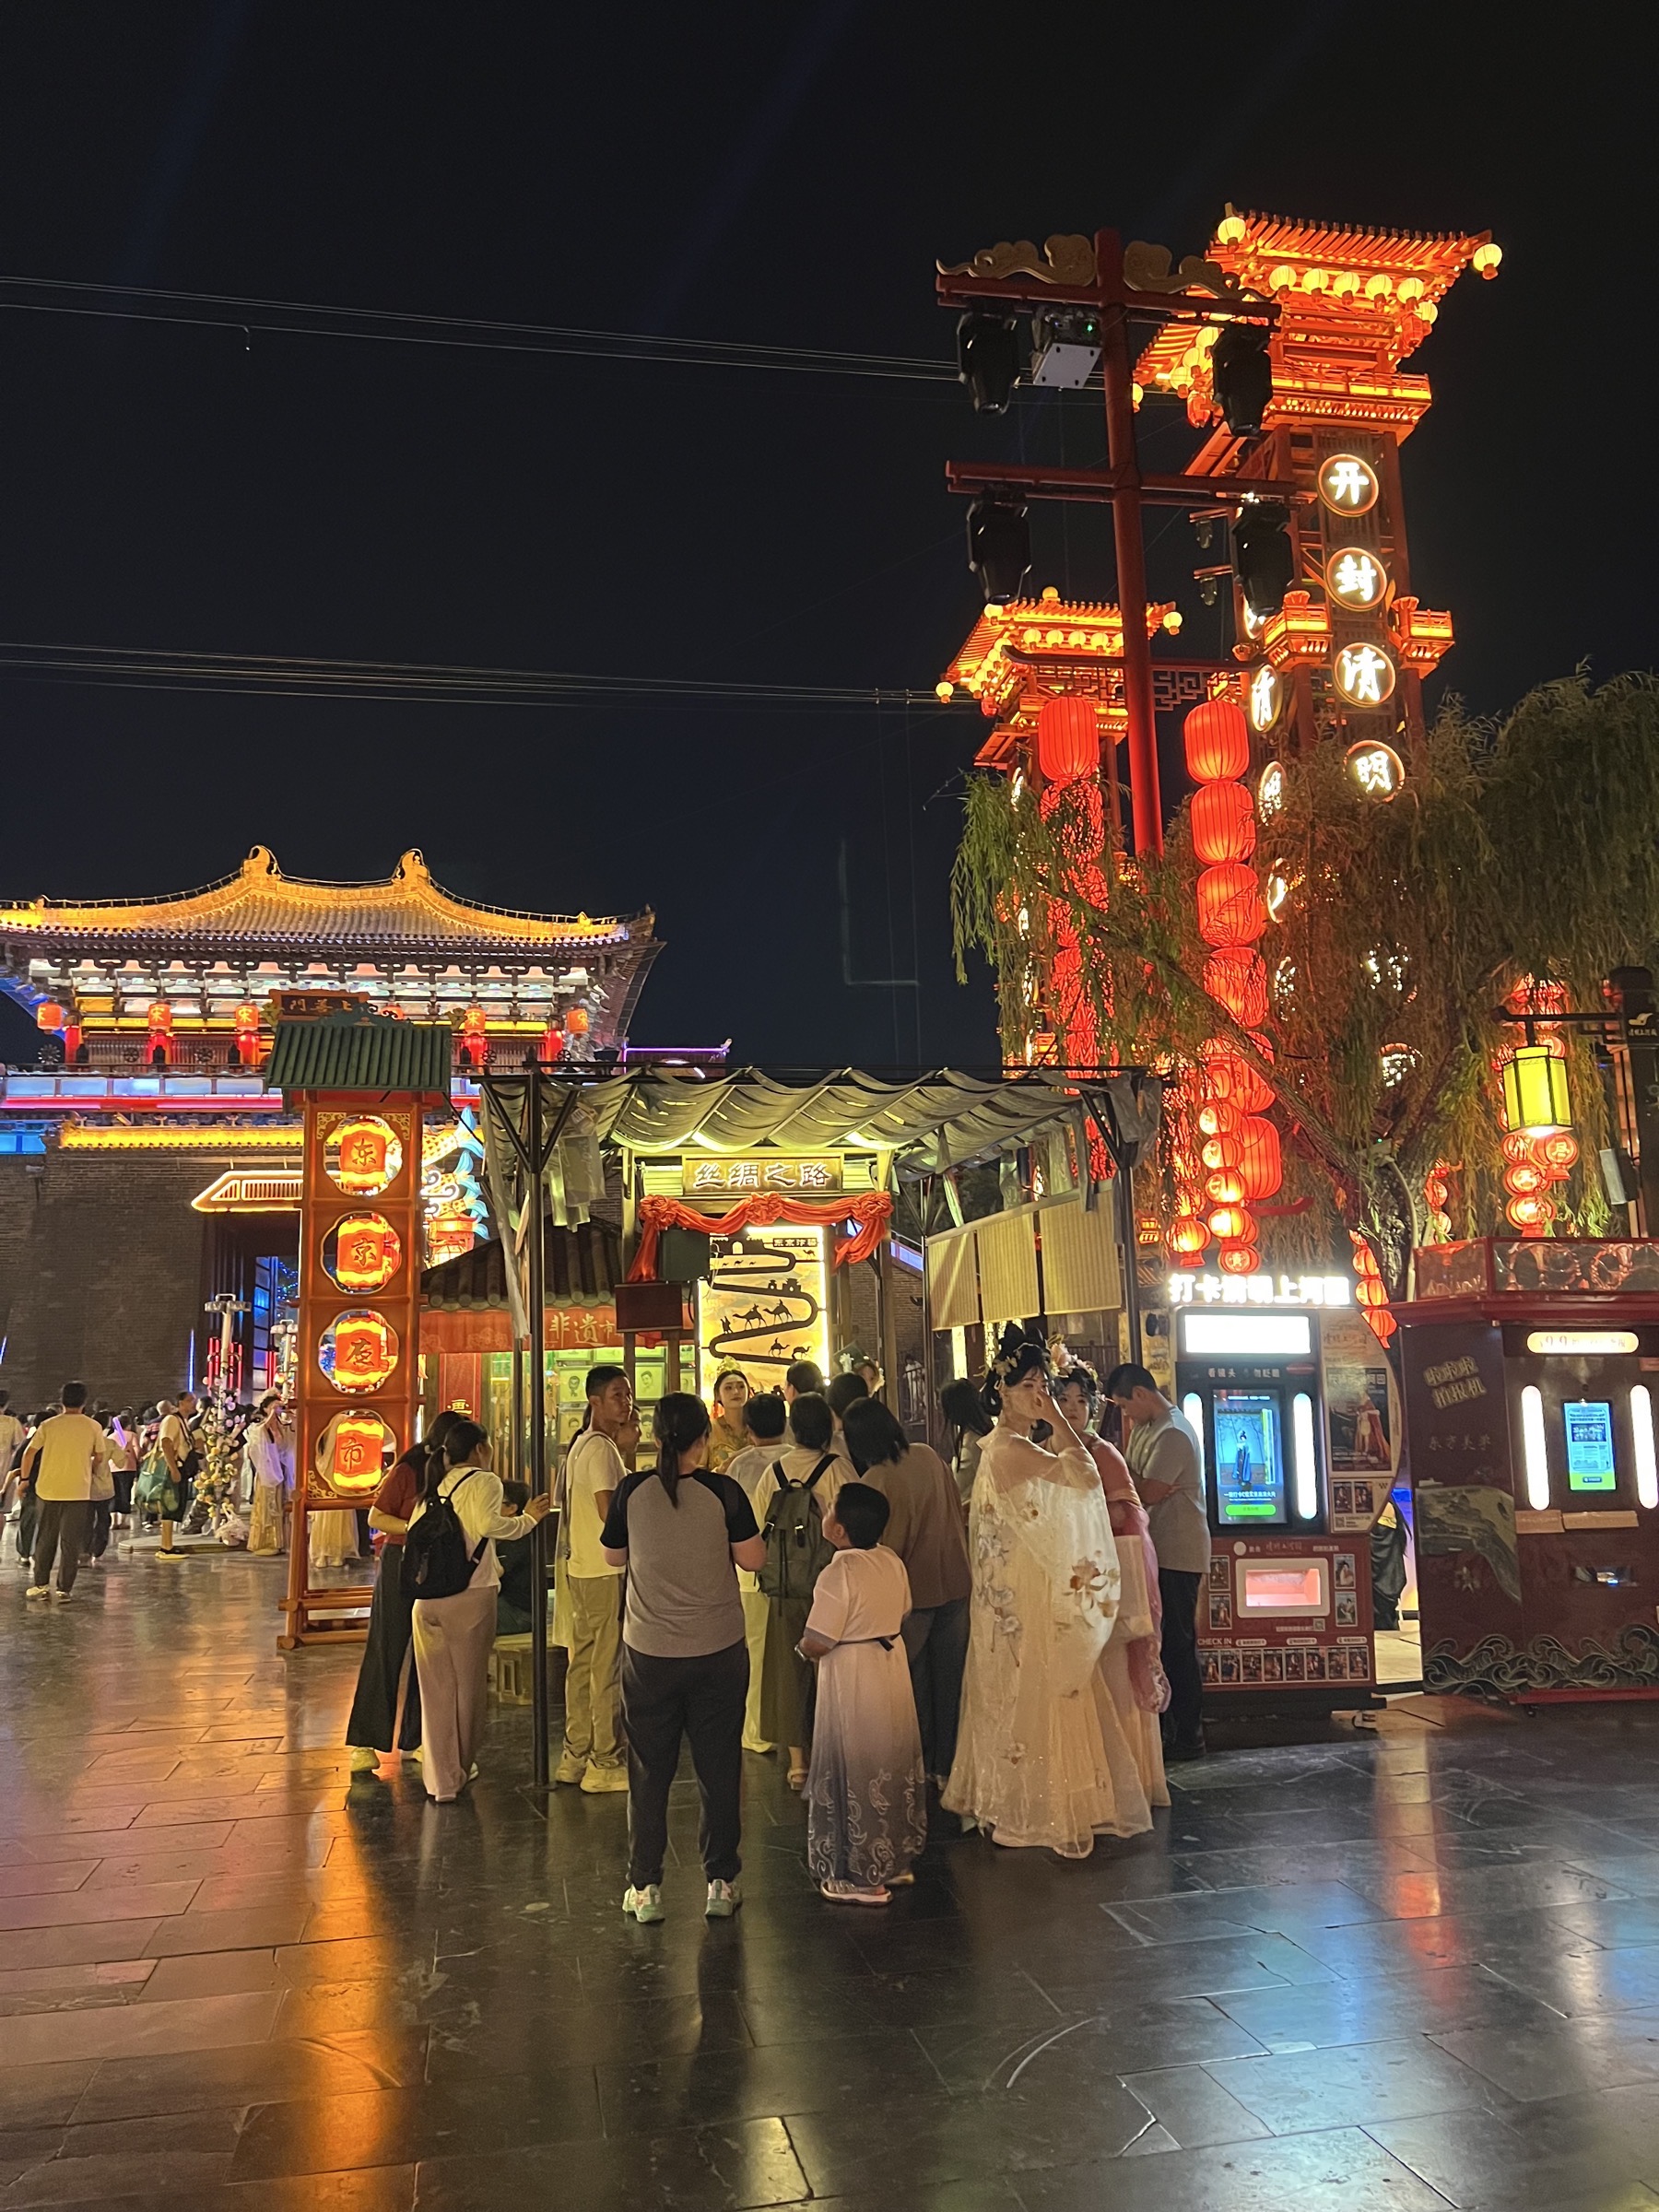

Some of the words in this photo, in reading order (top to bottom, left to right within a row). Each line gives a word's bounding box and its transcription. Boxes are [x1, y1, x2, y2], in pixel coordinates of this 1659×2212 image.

[693, 1162, 832, 1188] 丝绸之路
[1197, 1637, 1223, 1646] CHECK
[1223, 1637, 1232, 1645] IN
